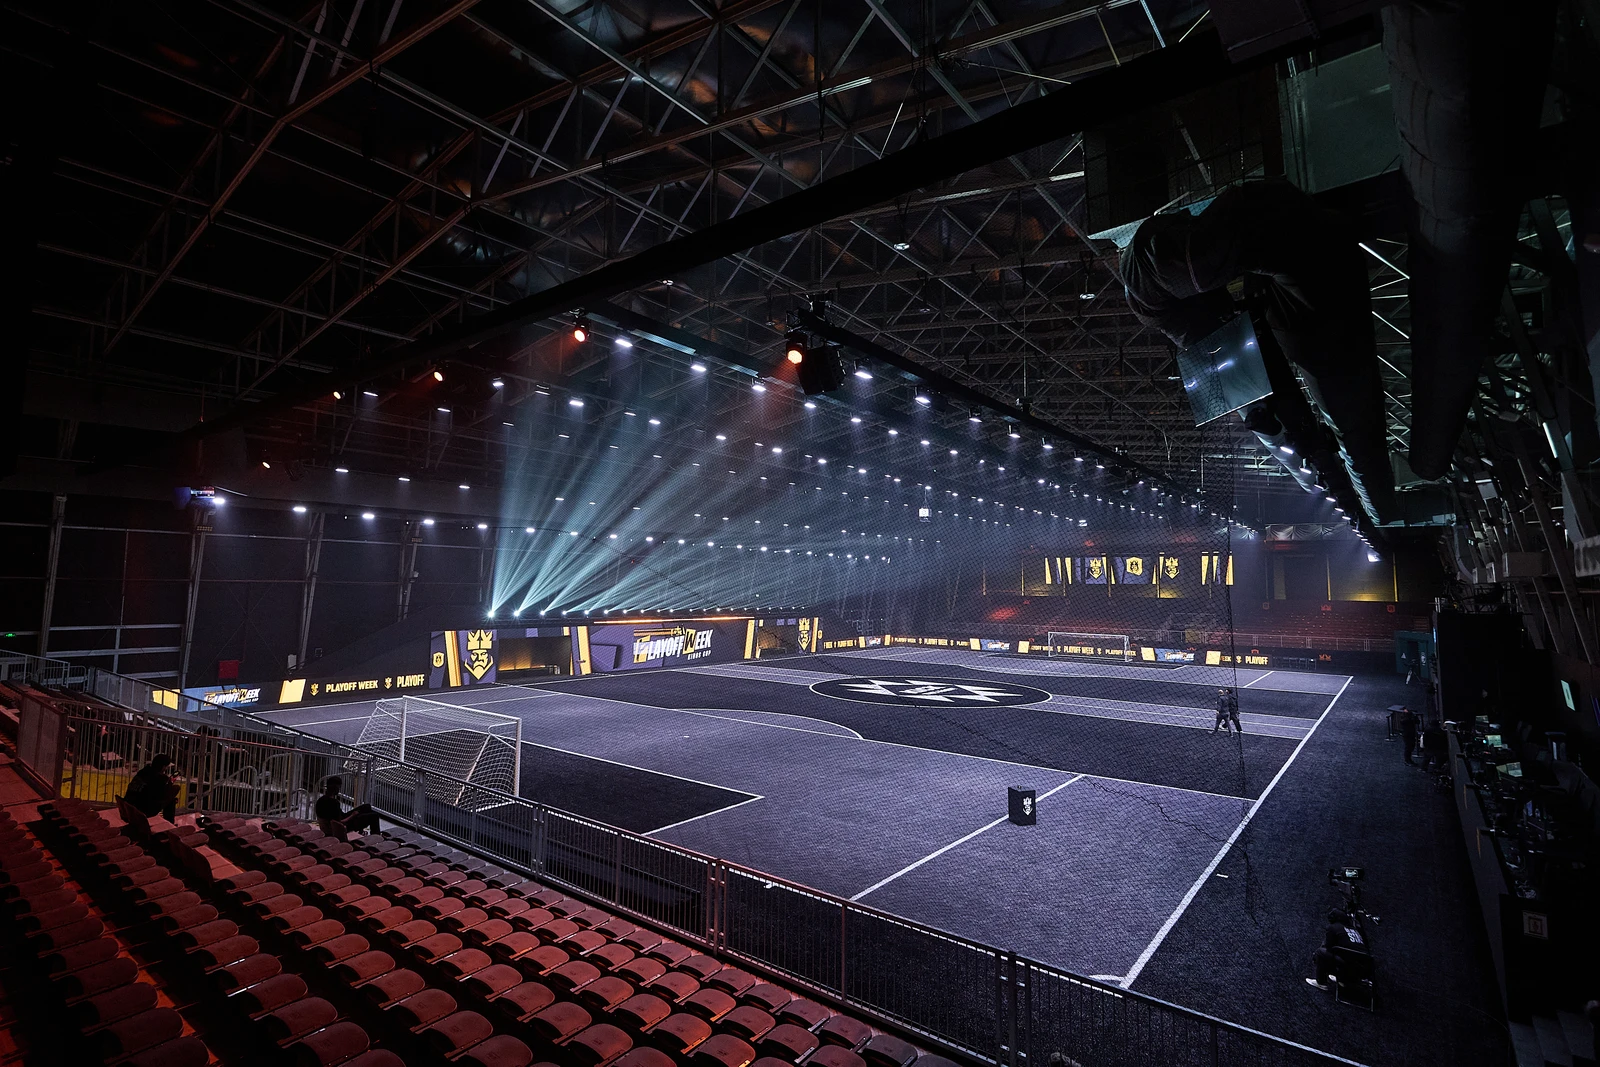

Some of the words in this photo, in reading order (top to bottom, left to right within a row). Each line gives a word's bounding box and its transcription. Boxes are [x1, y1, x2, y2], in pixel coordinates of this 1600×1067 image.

[683, 628, 714, 655] WEEK
[1081, 646, 1095, 655] WEEK
[1245, 655, 1269, 665] PLAYOFF
[325, 681, 358, 693] PLAYOFF
[358, 679, 379, 690] WEEK
[396, 673, 425, 688] PLAYOFF
